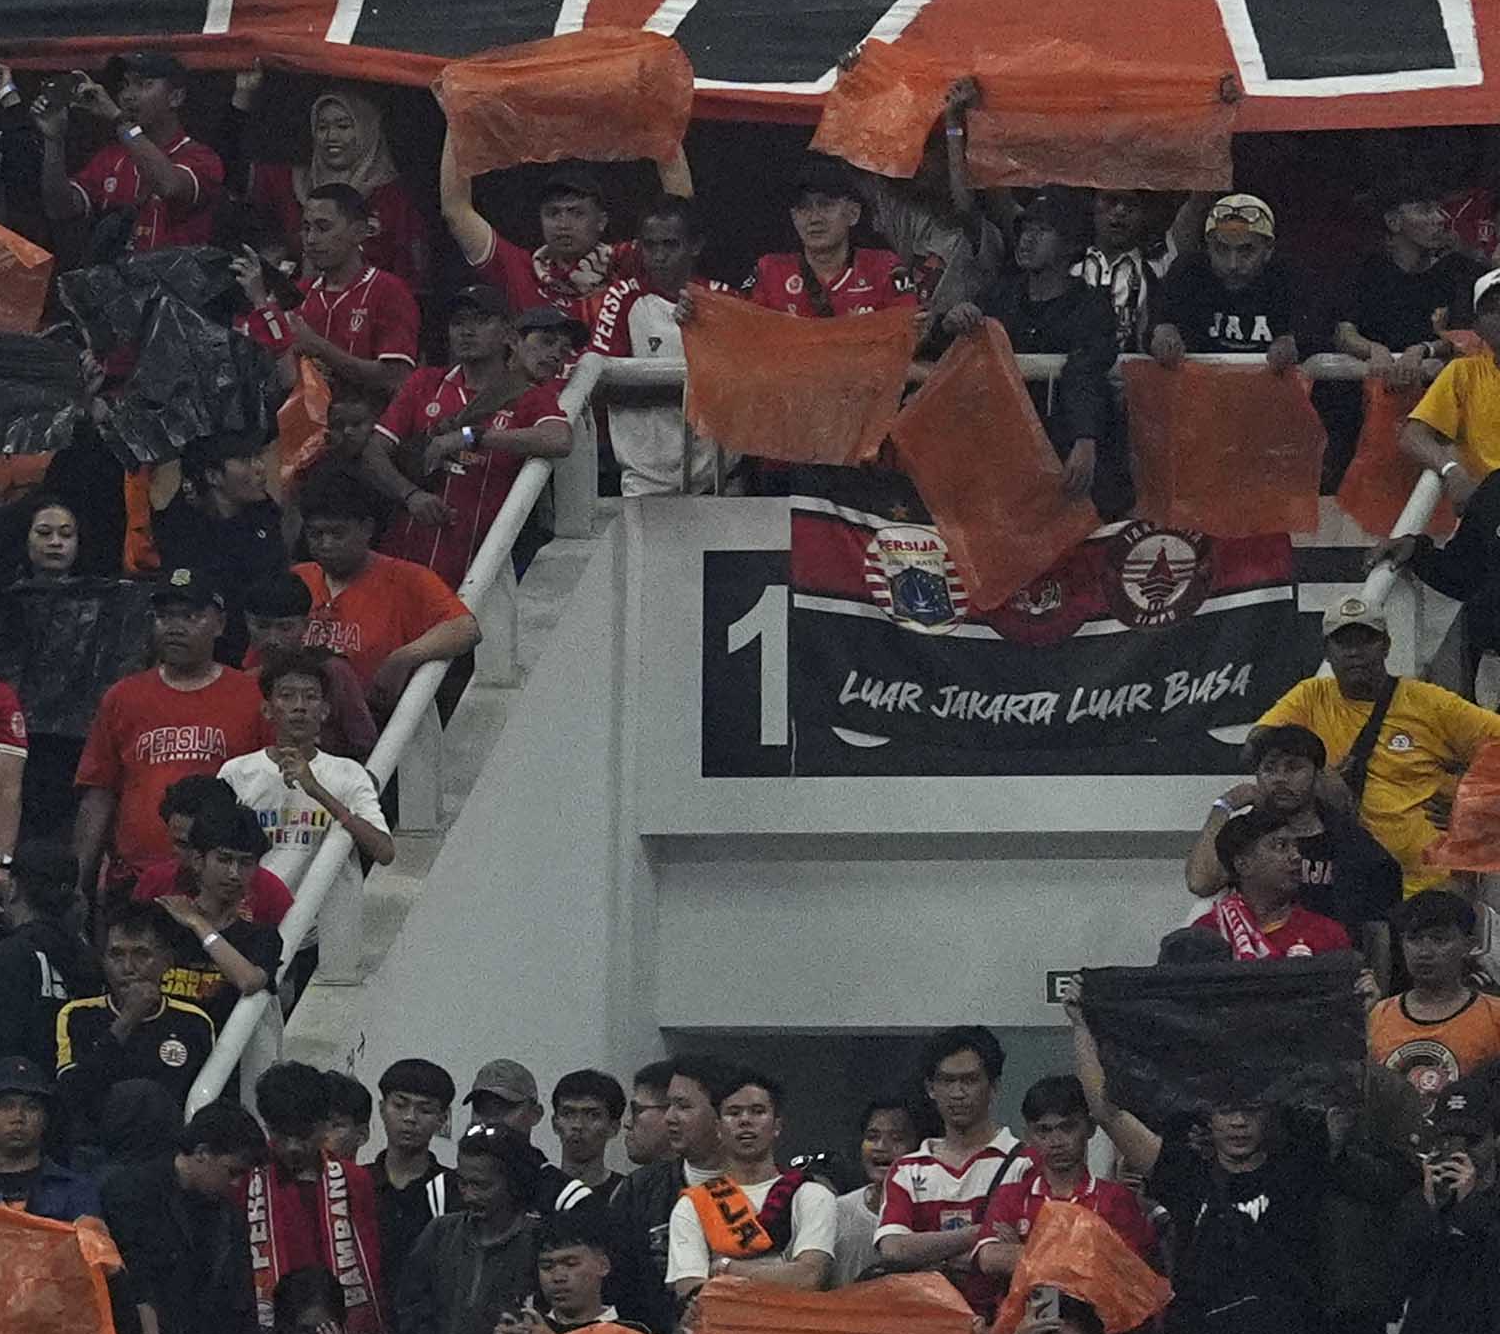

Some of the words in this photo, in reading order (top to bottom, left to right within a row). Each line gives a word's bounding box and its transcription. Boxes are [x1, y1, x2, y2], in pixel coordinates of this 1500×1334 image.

[879, 538, 940, 553] PERSIJA
[838, 670, 922, 714] LUAR
[930, 683, 1059, 726] JAKARTA
[1065, 681, 1153, 724] LUAR
[1163, 663, 1257, 714] BIASA
[136, 725, 228, 762] PERSIJA
